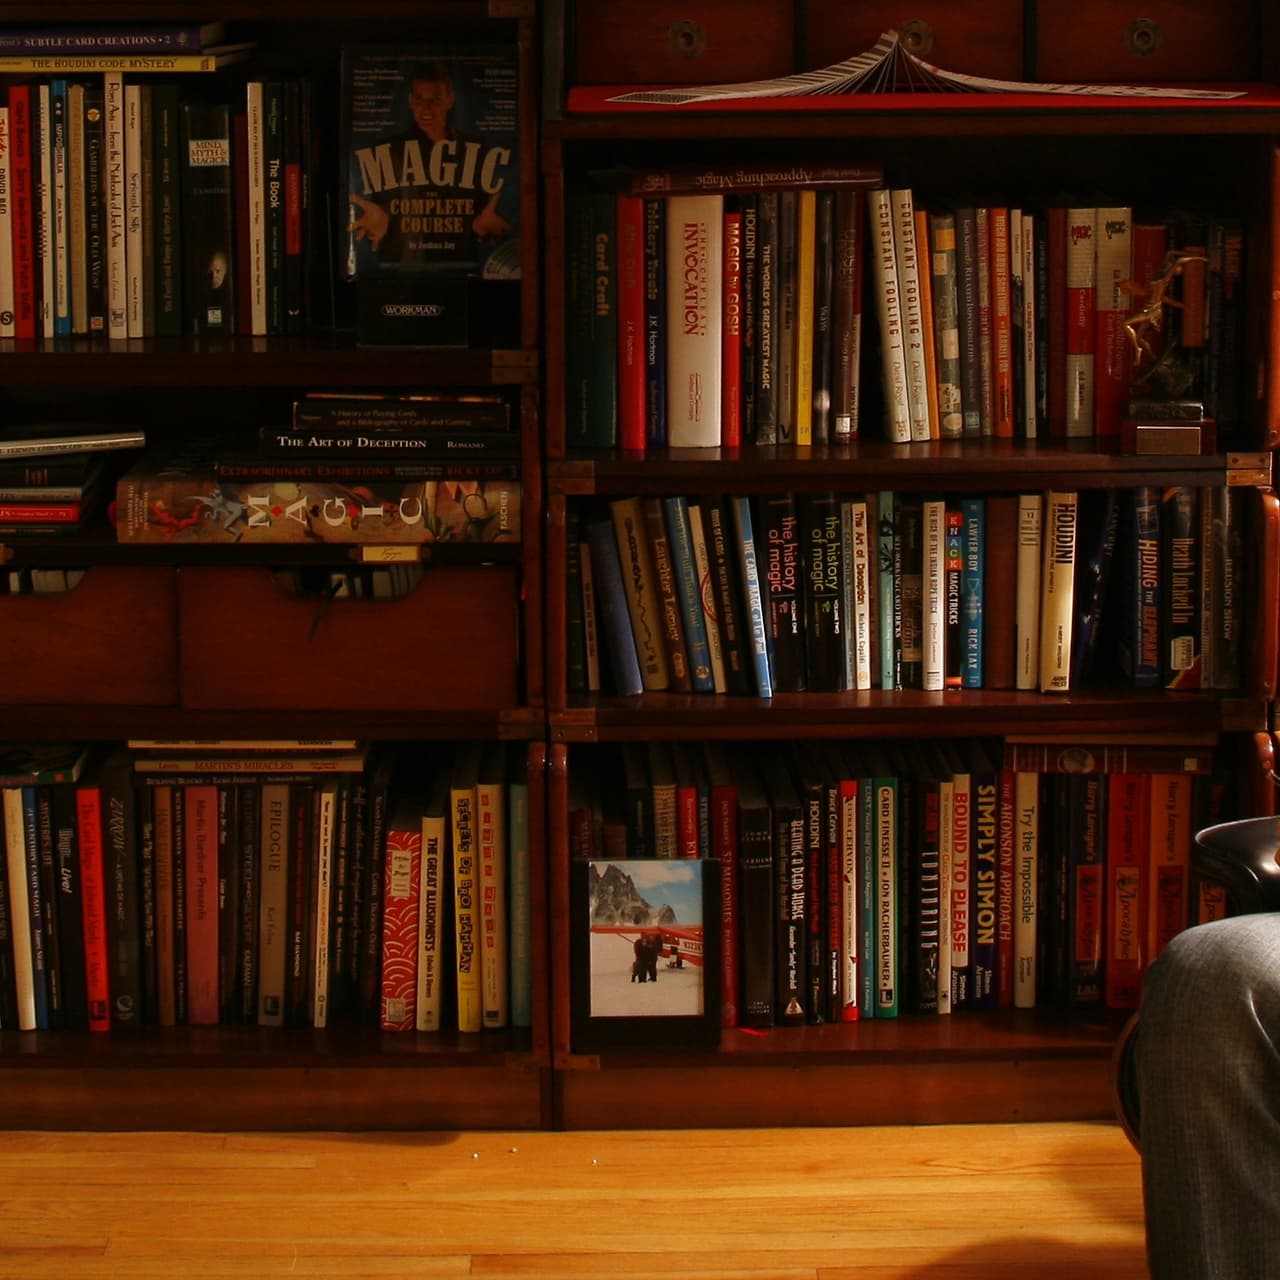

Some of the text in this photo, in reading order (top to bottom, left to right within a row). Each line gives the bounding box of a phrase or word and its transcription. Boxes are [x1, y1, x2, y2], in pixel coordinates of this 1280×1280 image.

[33, 58, 175, 68] THE HOUDINI CODE MYSTERY
[355, 139, 511, 194] MAGIC
[389, 200, 474, 215] COMPLETE
[400, 217, 463, 233] COURSE
[745, 208, 756, 258] HOUDINI
[879, 203, 893, 270] CONSTANT
[901, 203, 915, 270] CONSTANT
[596, 233, 608, 315] Card Craft
[684, 223, 700, 336] INVOCATION
[728, 223, 739, 336] MAGIC by GOSH
[762, 245, 770, 390] THE WORLD'S GREATEST MAGIC
[885, 281, 898, 334] FOOLING
[907, 280, 919, 334] FOOLING
[277, 436, 427, 448] THE ART OF DECEPTION
[769, 530, 783, 592] of magic
[782, 517, 795, 589] the history
[811, 529, 826, 591] of magic
[826, 517, 839, 589] the history
[968, 518, 979, 571] LAWYER BOY
[1055, 504, 1075, 563] HOUDINI
[1138, 539, 1157, 587] HIDING
[1172, 538, 1195, 623] Death Locked In
[1142, 606, 1157, 666] ELEPHANT
[269, 800, 281, 872] EPILOGUE
[977, 785, 995, 944] SIMPLY SIMON
[1022, 806, 1034, 923] Try the Impossible
[425, 838, 437, 951] THE GREAT ILLUSIONISTS
[953, 793, 968, 951] BOUND TO PLEASE
